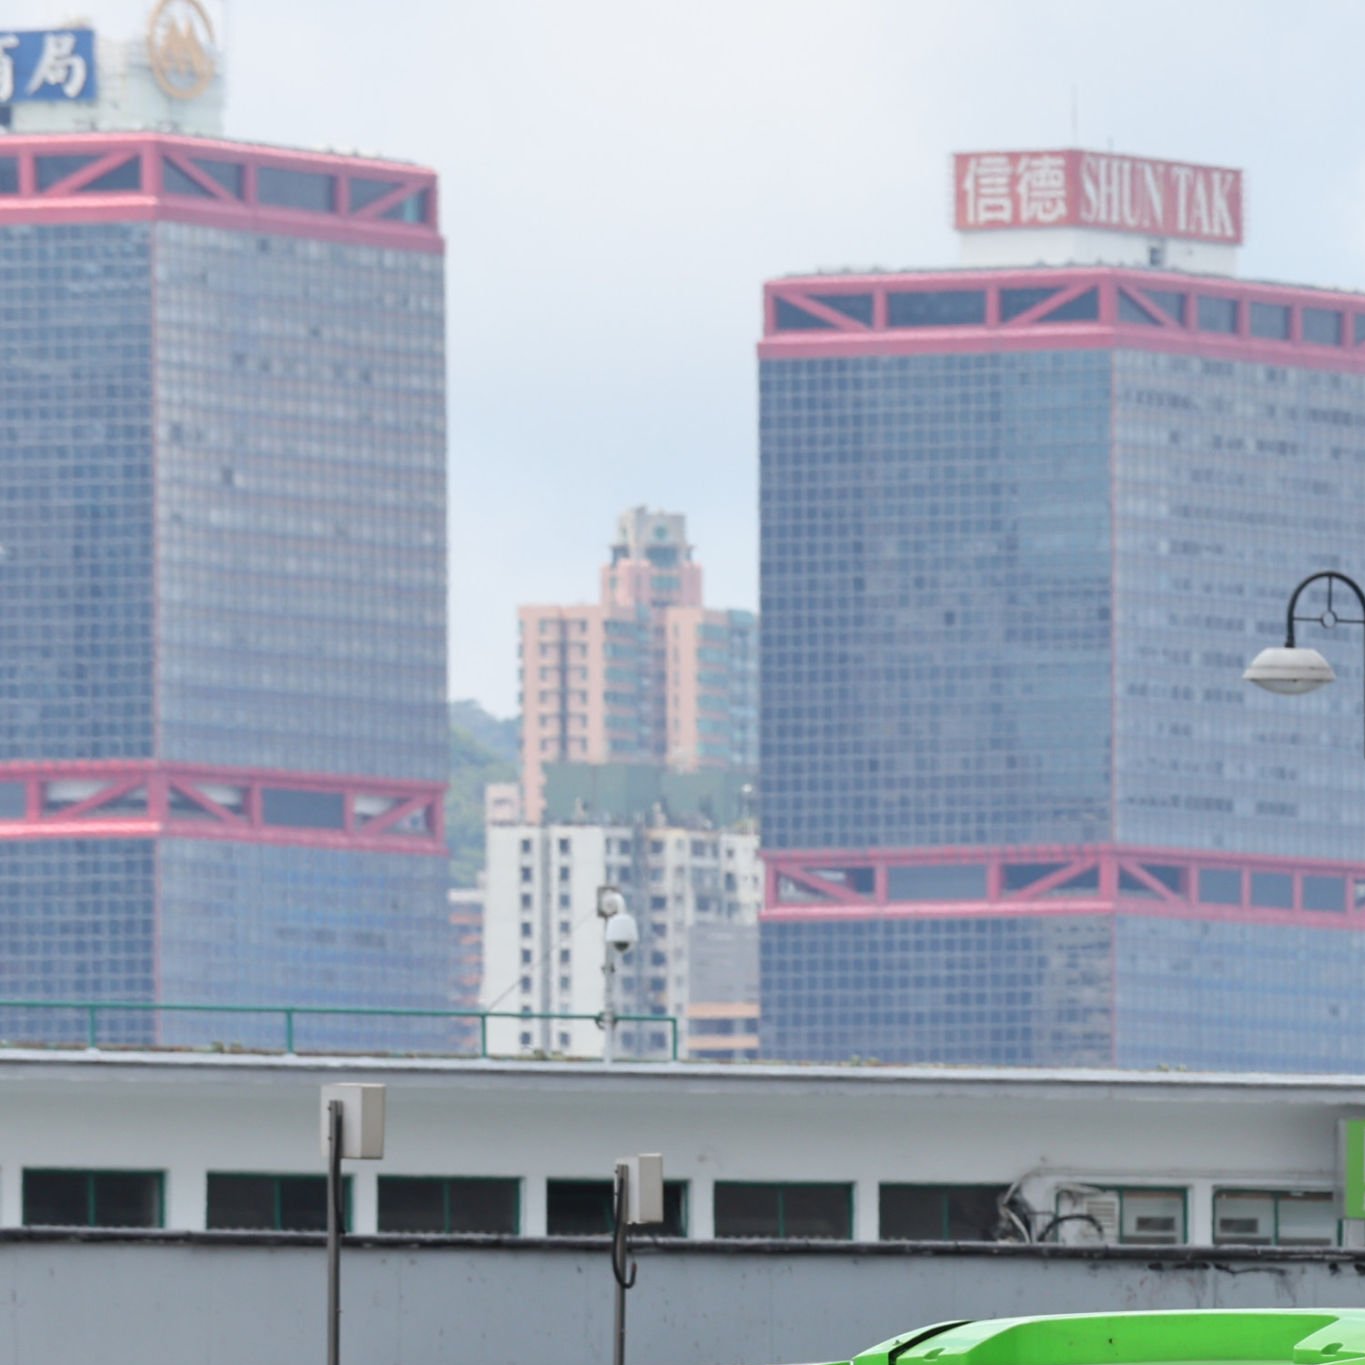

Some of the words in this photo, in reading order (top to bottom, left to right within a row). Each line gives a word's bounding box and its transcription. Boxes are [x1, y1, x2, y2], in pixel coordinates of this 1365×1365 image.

[963, 155, 1068, 224] 信德
[1079, 156, 1166, 229] SHUN
[1174, 168, 1236, 238] TAK
